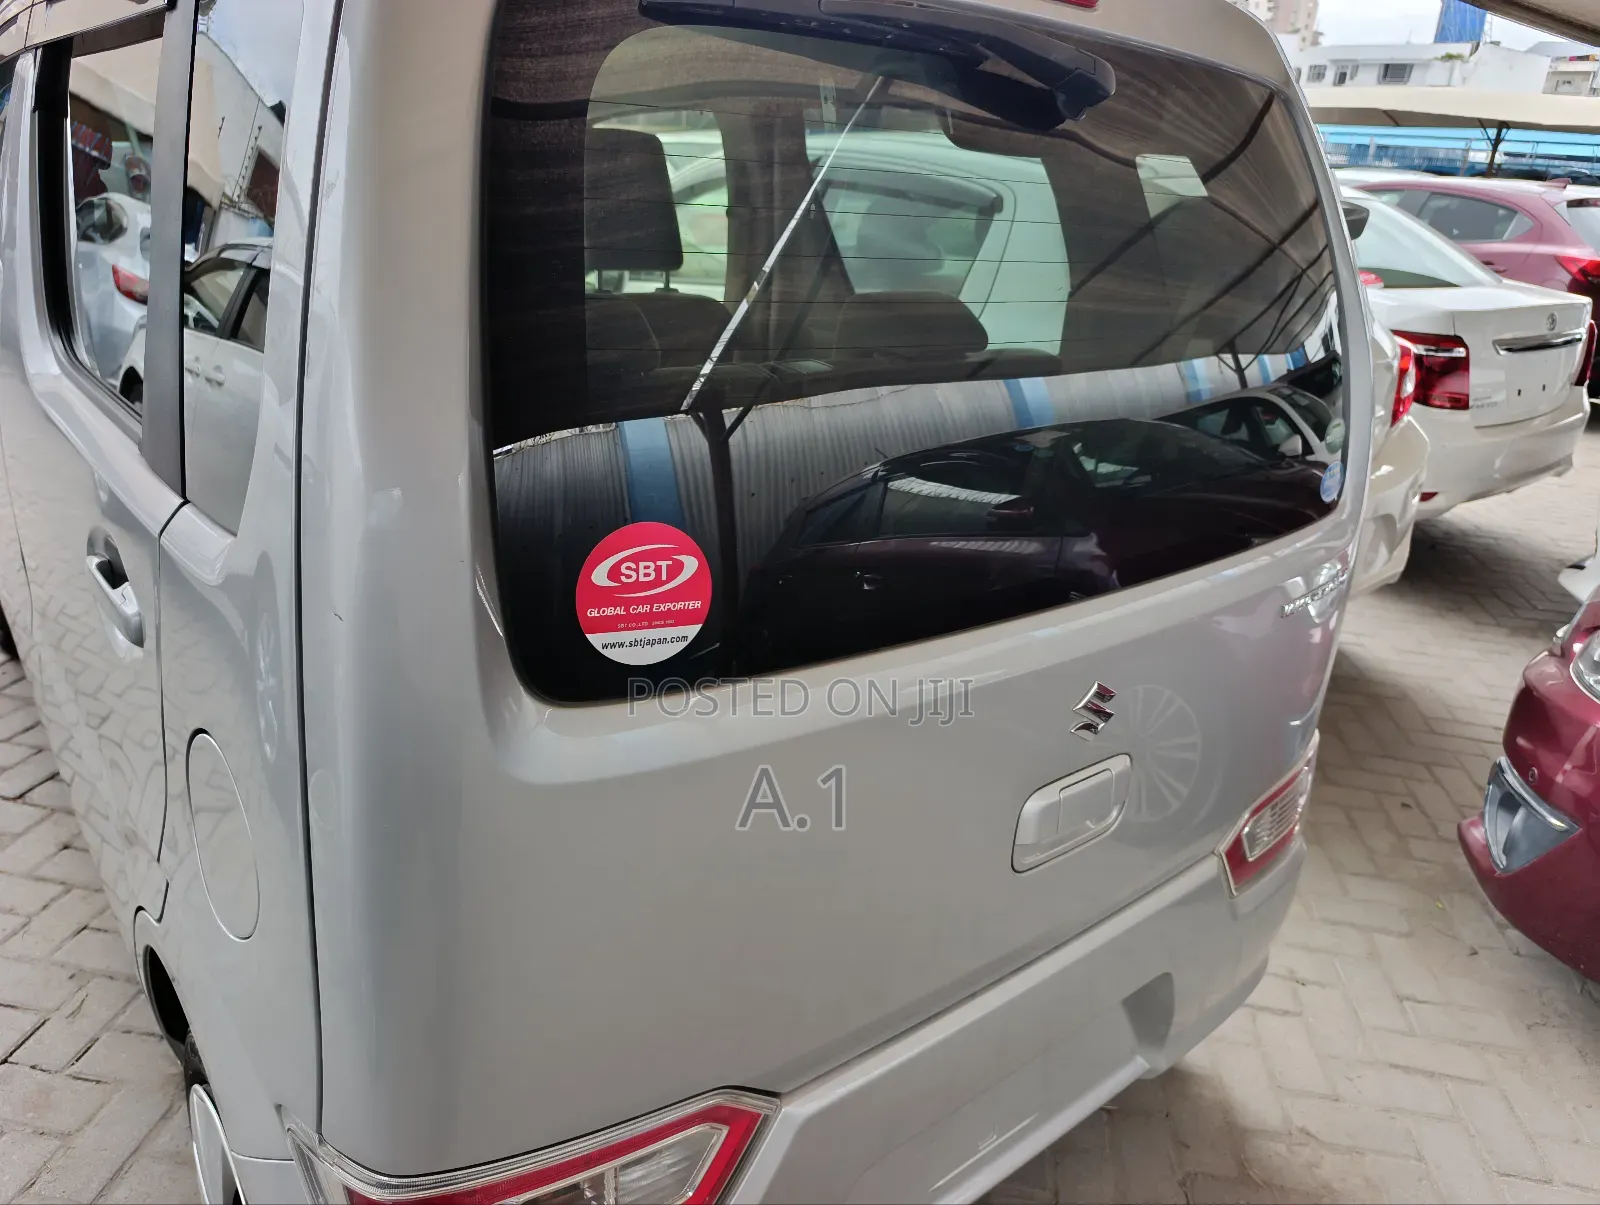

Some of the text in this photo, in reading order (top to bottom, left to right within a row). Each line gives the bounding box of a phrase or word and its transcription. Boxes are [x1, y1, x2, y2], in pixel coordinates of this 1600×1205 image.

[620, 561, 672, 583] SBT
[586, 600, 701, 617] GLOBAL CAR EXPORTER
[601, 635, 689, 650] www.sbtjapan.com
